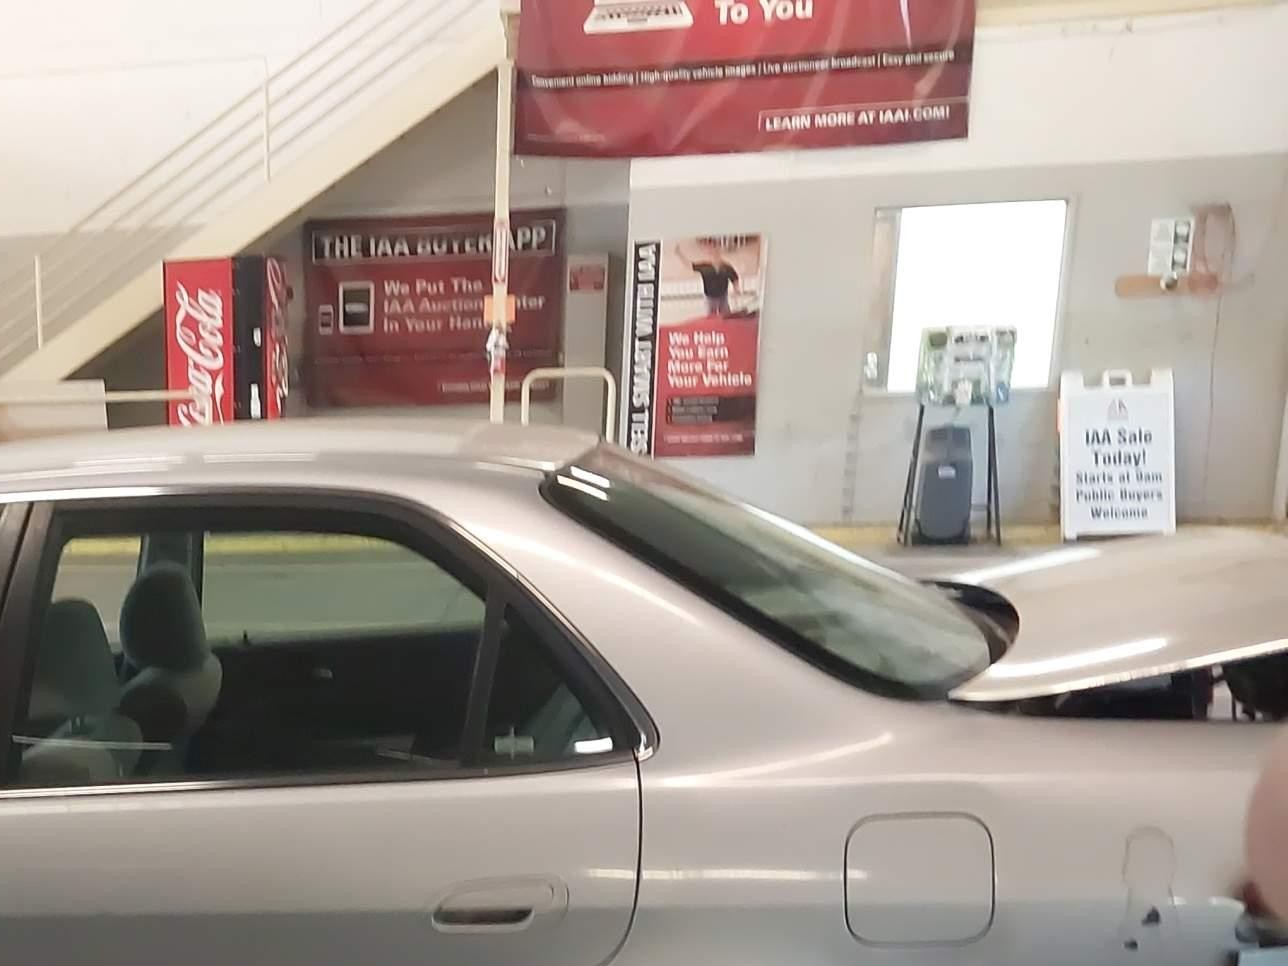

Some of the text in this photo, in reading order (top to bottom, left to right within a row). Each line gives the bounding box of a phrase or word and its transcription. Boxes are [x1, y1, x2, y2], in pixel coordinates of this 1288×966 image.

[716, 0, 813, 25] To You
[603, 72, 633, 86] bidding
[692, 65, 723, 80] vehicle
[725, 64, 756, 78] images
[763, 62, 780, 75] Live
[831, 54, 875, 70] broadcast
[882, 52, 903, 67] Easy
[905, 51, 922, 65] and
[923, 49, 955, 63] secure
[765, 114, 810, 132] LEARN
[814, 112, 854, 128] MORE
[857, 110, 876, 125] AT
[322, 235, 361, 258] THE
[369, 235, 410, 257] IAA
[638, 244, 656, 280] IAA
[383, 277, 483, 296] We Put The
[383, 298, 415, 314] IAA
[419, 297, 483, 313] Auction
[635, 283, 654, 337] WITH
[383, 317, 400, 333] In
[405, 316, 443, 333] Your
[669, 330, 725, 347] We Help
[669, 344, 729, 360] You Earn
[633, 339, 652, 407] SMART
[668, 358, 728, 374] More For
[668, 371, 752, 388] Your Vehicle
[1085, 427, 1152, 445] IAA Sale
[1094, 449, 1146, 466] Today!
[1076, 471, 1113, 484] Starts
[1119, 471, 1130, 483] at
[1076, 487, 1163, 502] Public Buyers
[1091, 506, 1148, 519] Welcome
